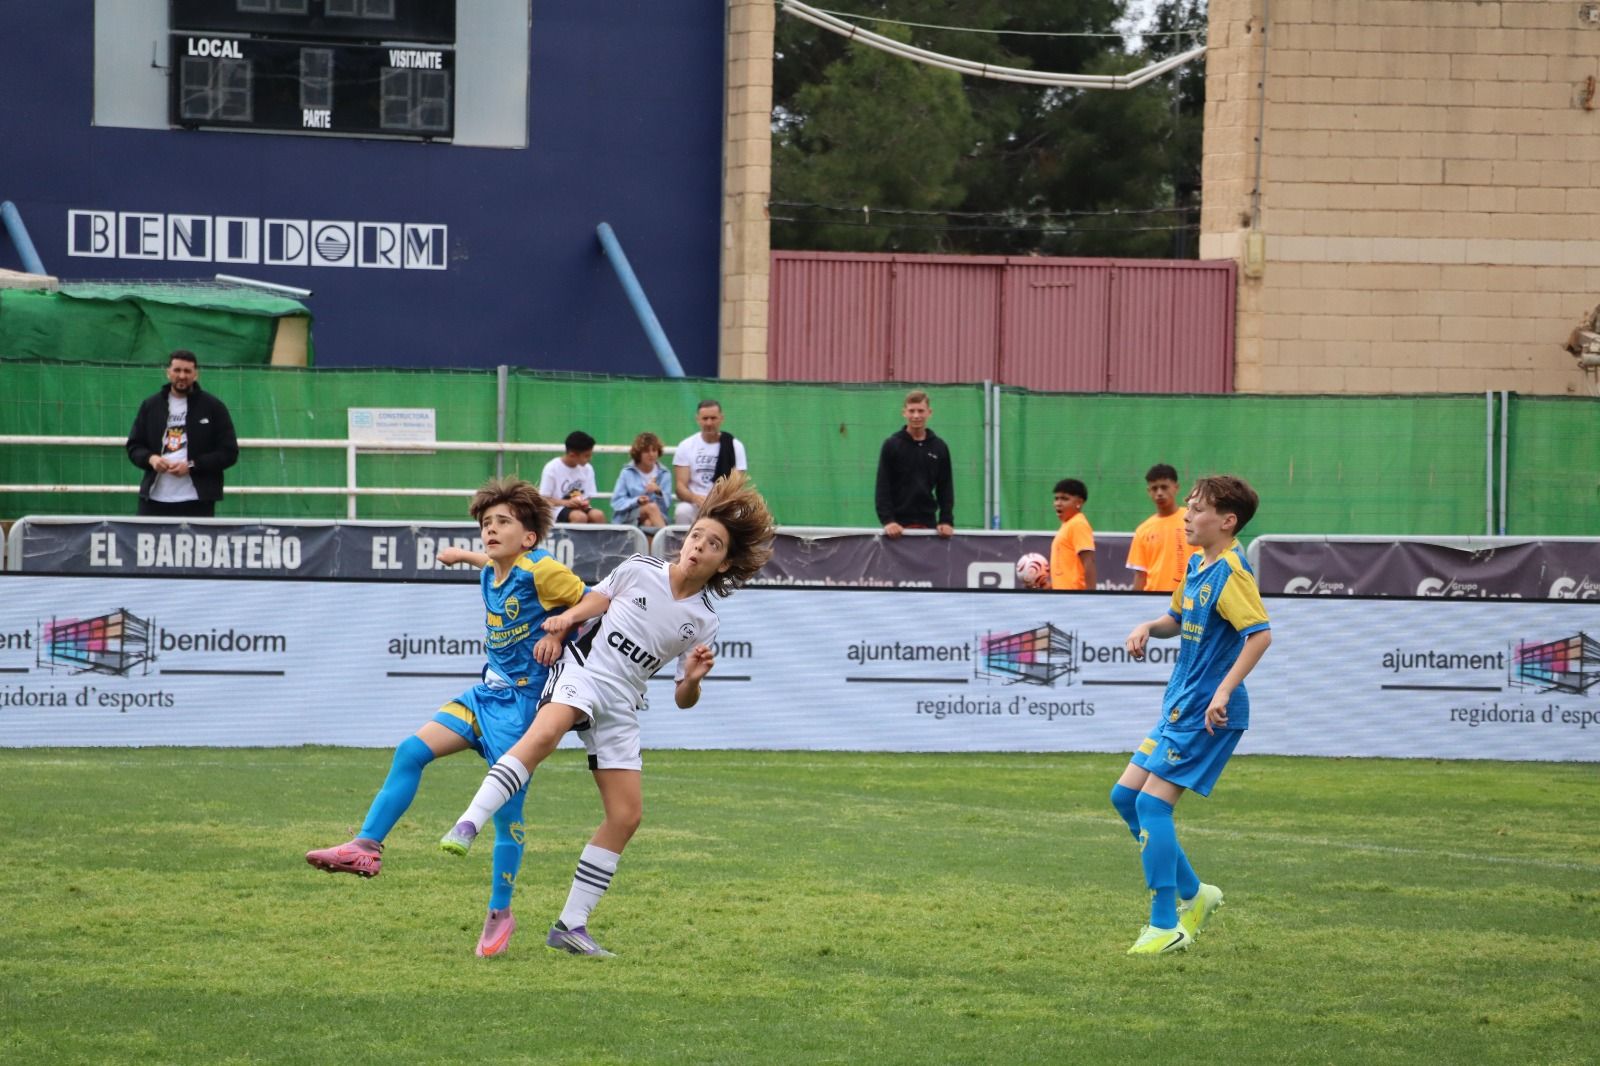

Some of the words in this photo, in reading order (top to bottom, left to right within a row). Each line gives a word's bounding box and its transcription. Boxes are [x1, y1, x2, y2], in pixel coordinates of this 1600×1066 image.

[188, 38, 243, 59] LOCAL
[389, 50, 442, 69] VISITANTE
[303, 110, 331, 128] PARTE
[68, 210, 447, 270] BENIDORM
[90, 533, 122, 567] EL
[137, 530, 301, 569] BARBATEÑO
[372, 536, 402, 570] EL
[159, 628, 286, 653] benidorm
[847, 640, 971, 666] ajuntament
[1382, 648, 1504, 673] ajuntament
[0, 685, 67, 707] idoria
[916, 695, 1002, 720] regidoria
[1450, 703, 1536, 728] regidoria
